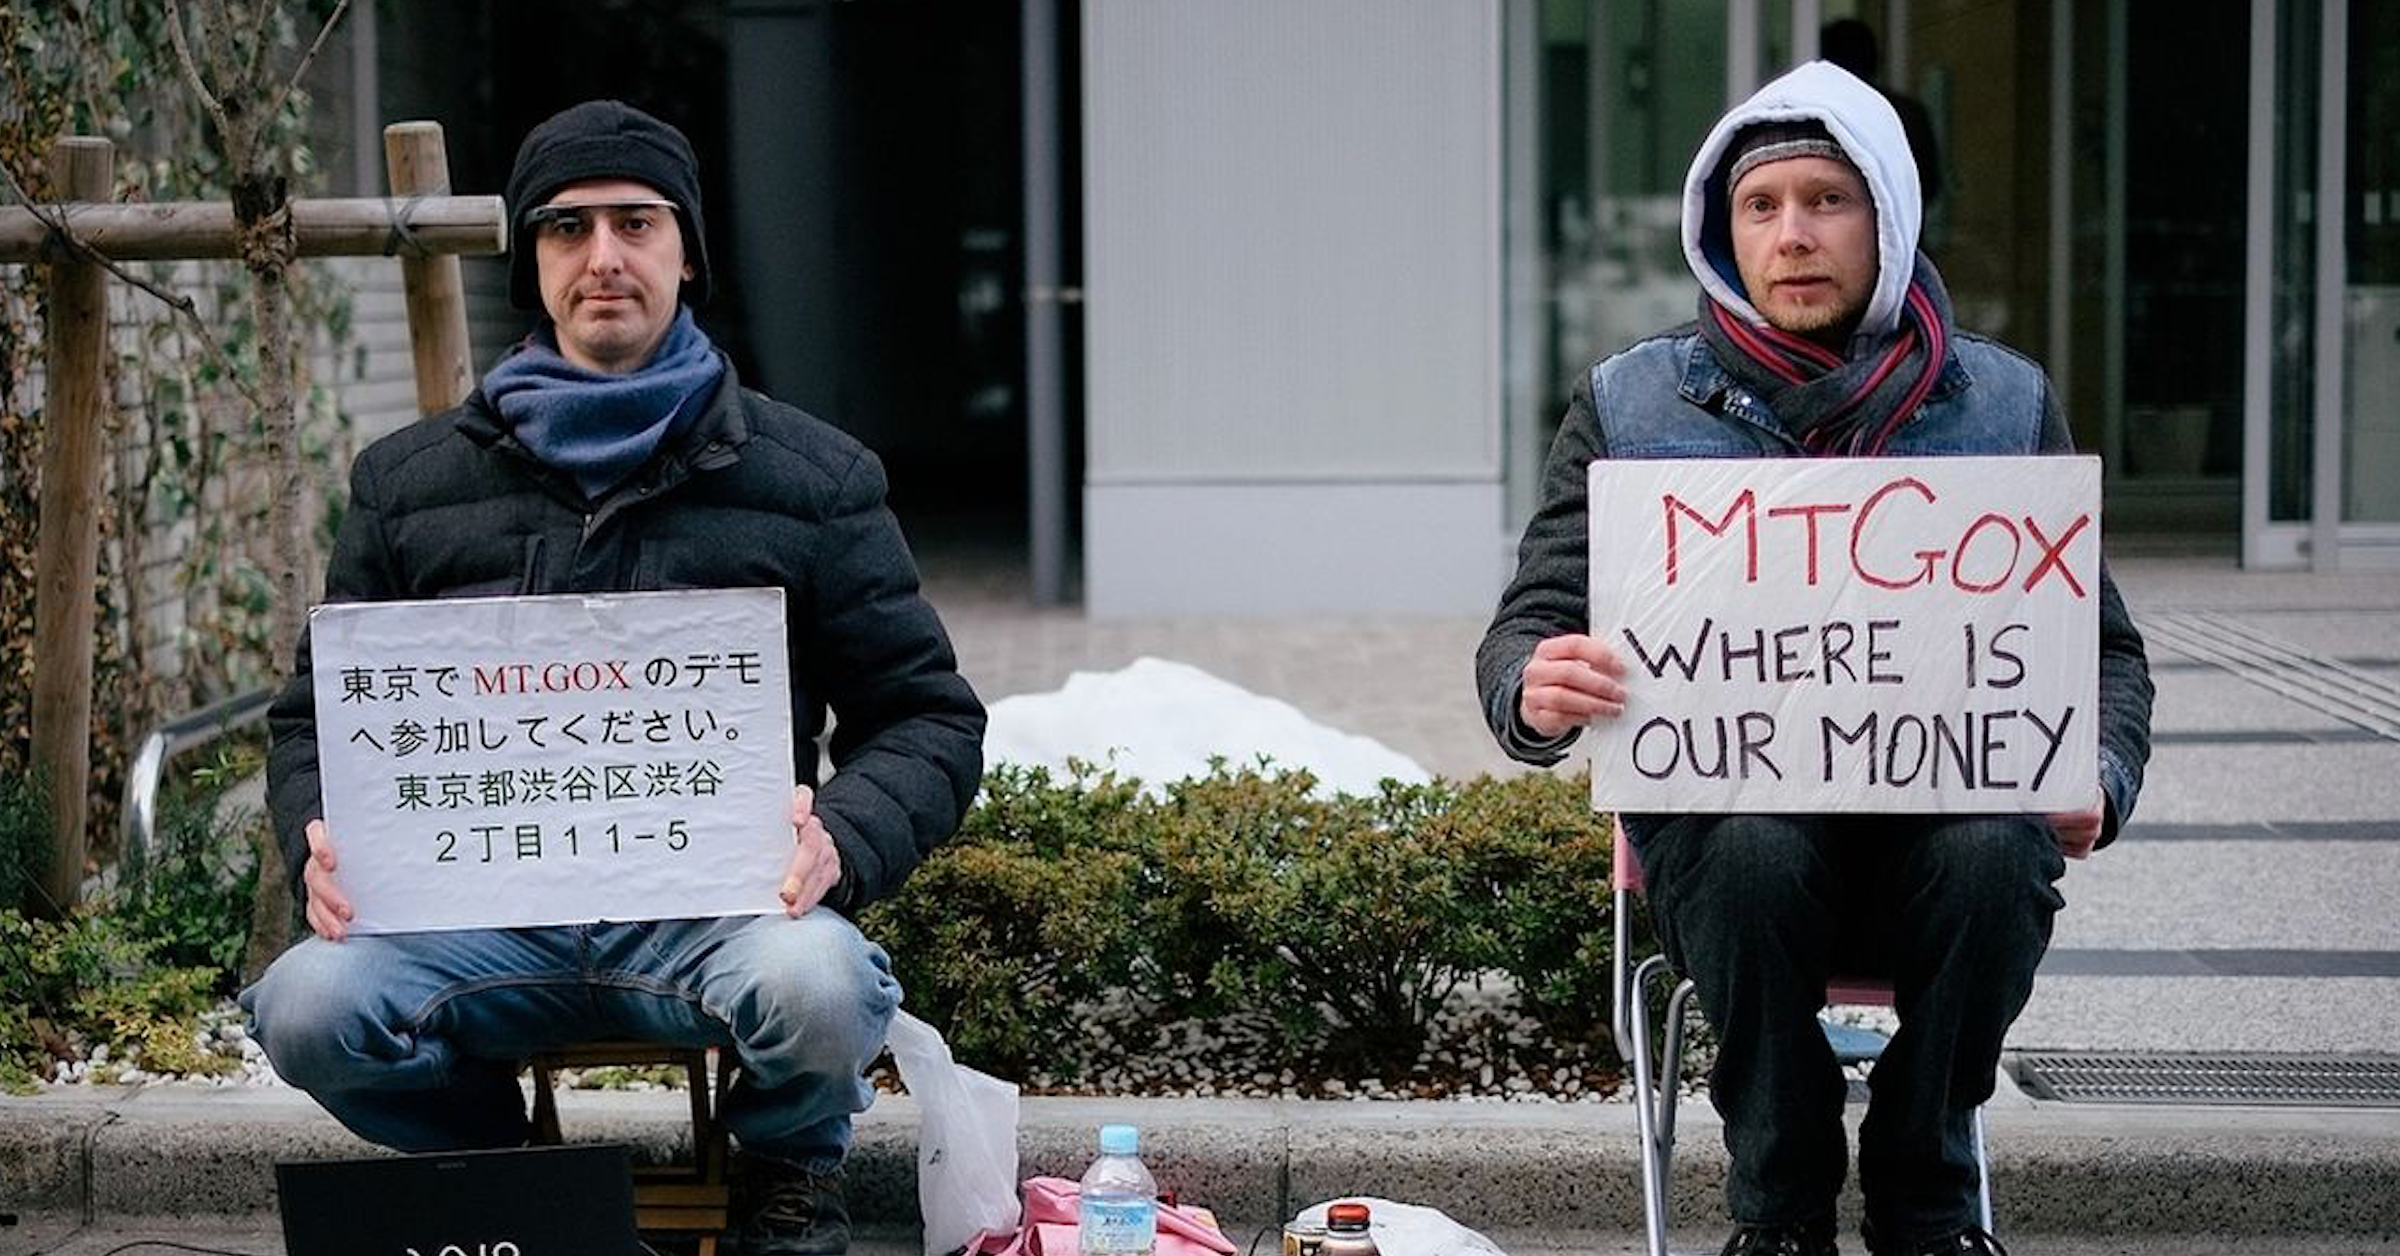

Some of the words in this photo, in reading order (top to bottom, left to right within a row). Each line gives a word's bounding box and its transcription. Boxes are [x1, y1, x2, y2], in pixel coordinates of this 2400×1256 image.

[340, 664, 459, 703] 東京で
[472, 660, 632, 695] MT.GOX
[645, 652, 763, 687] のデモ
[1622, 618, 1904, 685] WHERE
[1964, 623, 2030, 689] IS
[350, 708, 740, 757] へ参加してください。
[1631, 711, 1783, 780] OUR
[1821, 706, 2075, 792] MONEY
[394, 760, 725, 811] 東京都渋谷区渋谷
